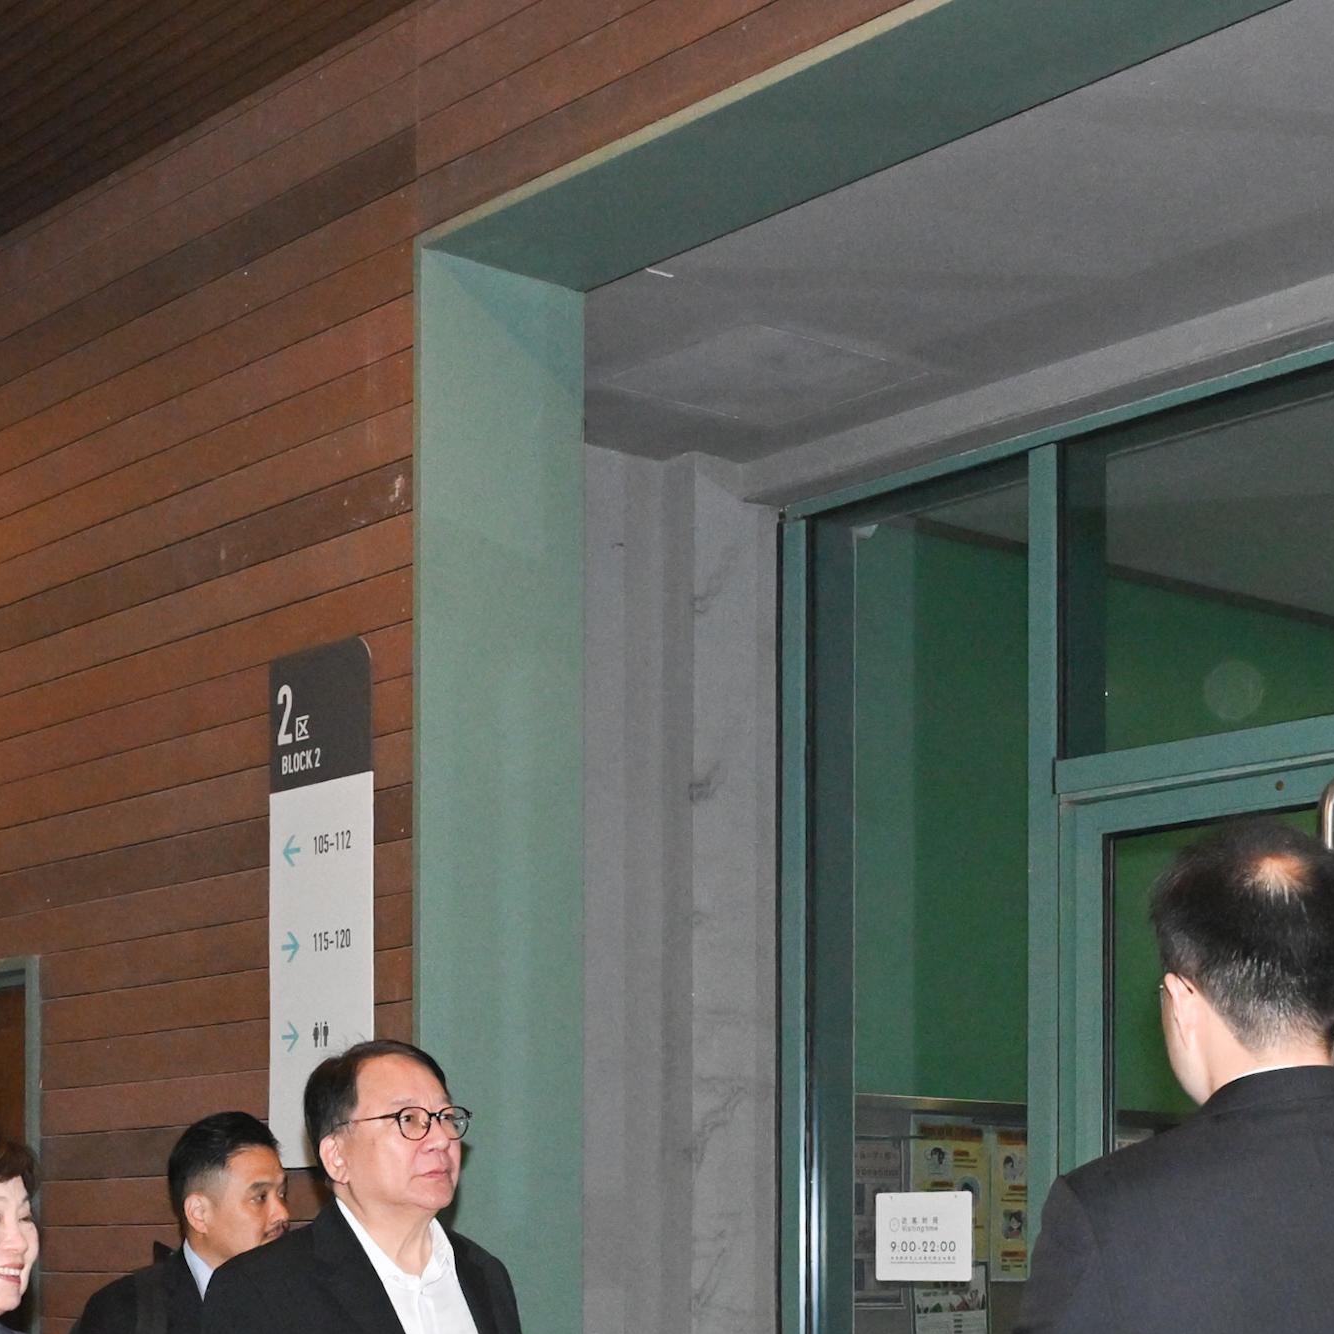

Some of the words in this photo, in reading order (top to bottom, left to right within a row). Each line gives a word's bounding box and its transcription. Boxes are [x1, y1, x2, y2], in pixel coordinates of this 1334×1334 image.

[277, 684, 309, 746] 2区
[281, 749, 313, 775] BLOCK
[314, 747, 321, 767] 2
[313, 829, 351, 855] 105-112
[313, 928, 351, 952] 115-120
